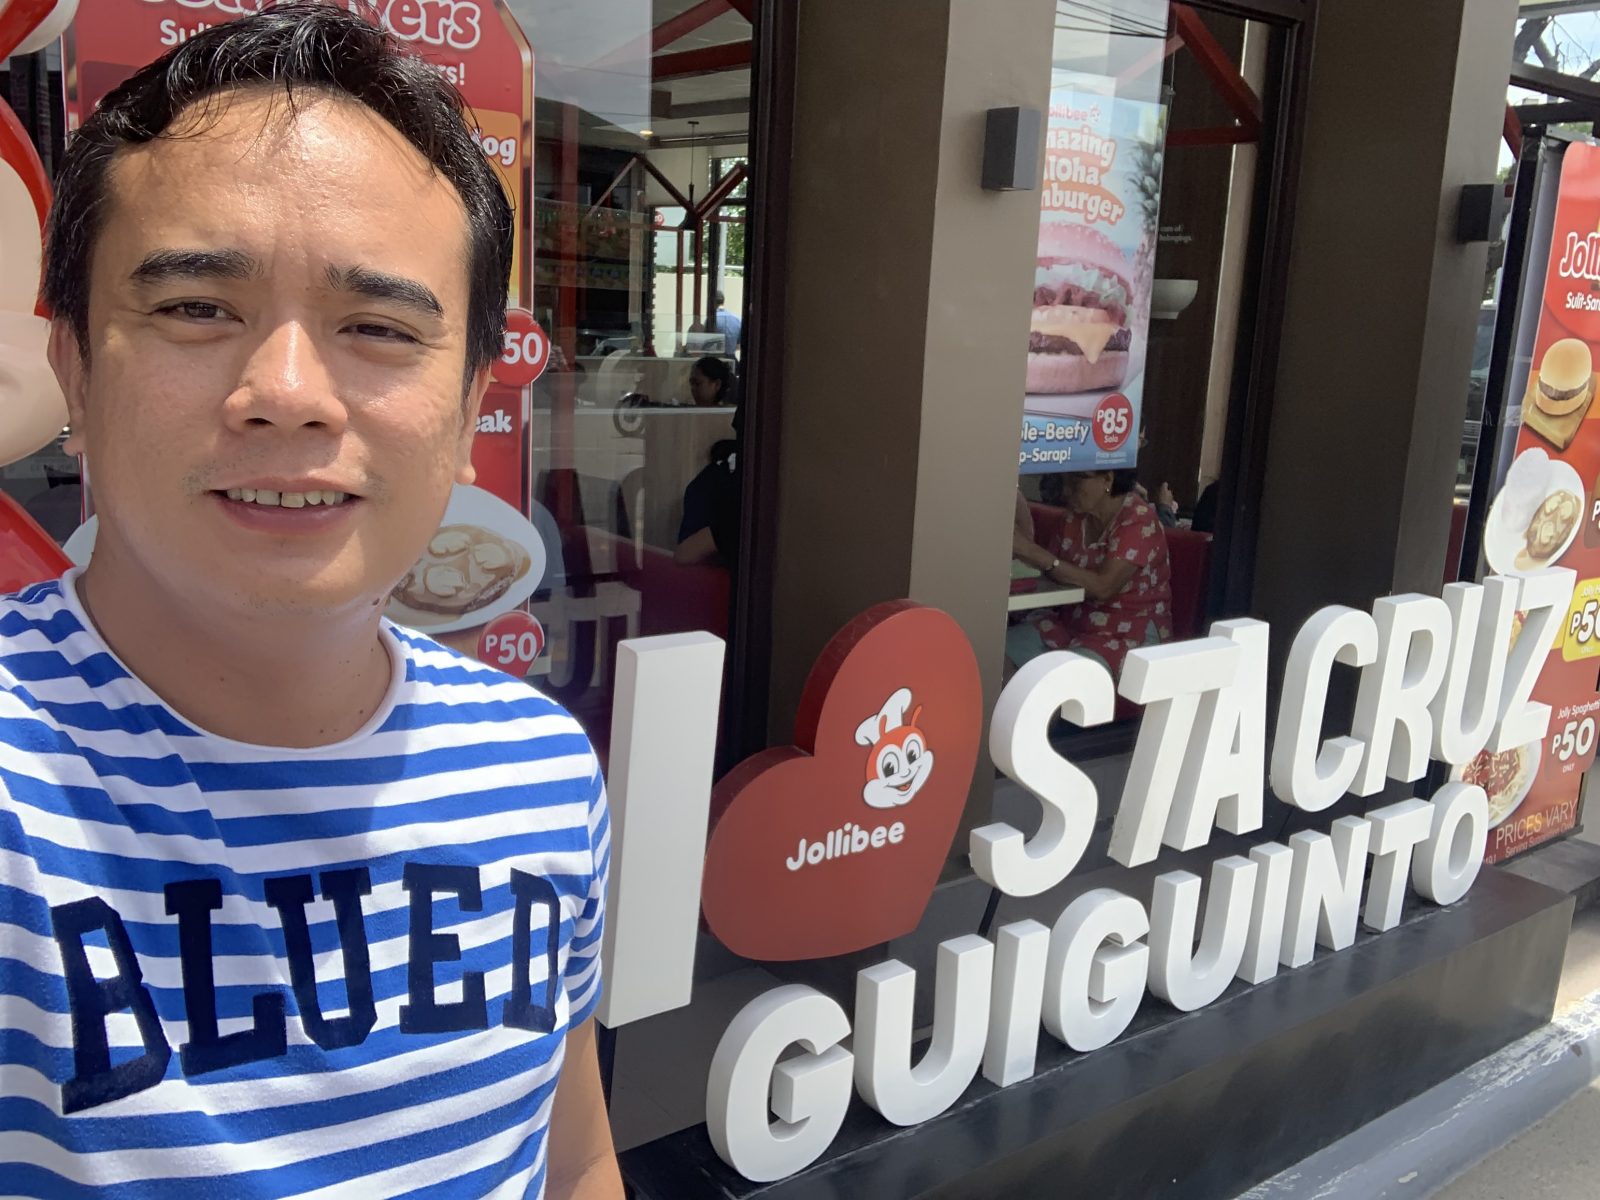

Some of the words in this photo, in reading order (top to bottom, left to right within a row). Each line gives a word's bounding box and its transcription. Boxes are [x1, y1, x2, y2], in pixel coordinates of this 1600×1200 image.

[485, 631, 537, 665] P50
[1551, 716, 1596, 761] P50
[786, 821, 905, 871] Jollibee
[1496, 812, 1543, 850] PRICES
[1545, 798, 1578, 828] VARY
[52, 862, 561, 1115] BLUED
[706, 783, 1489, 1183] GUIGUINTO
